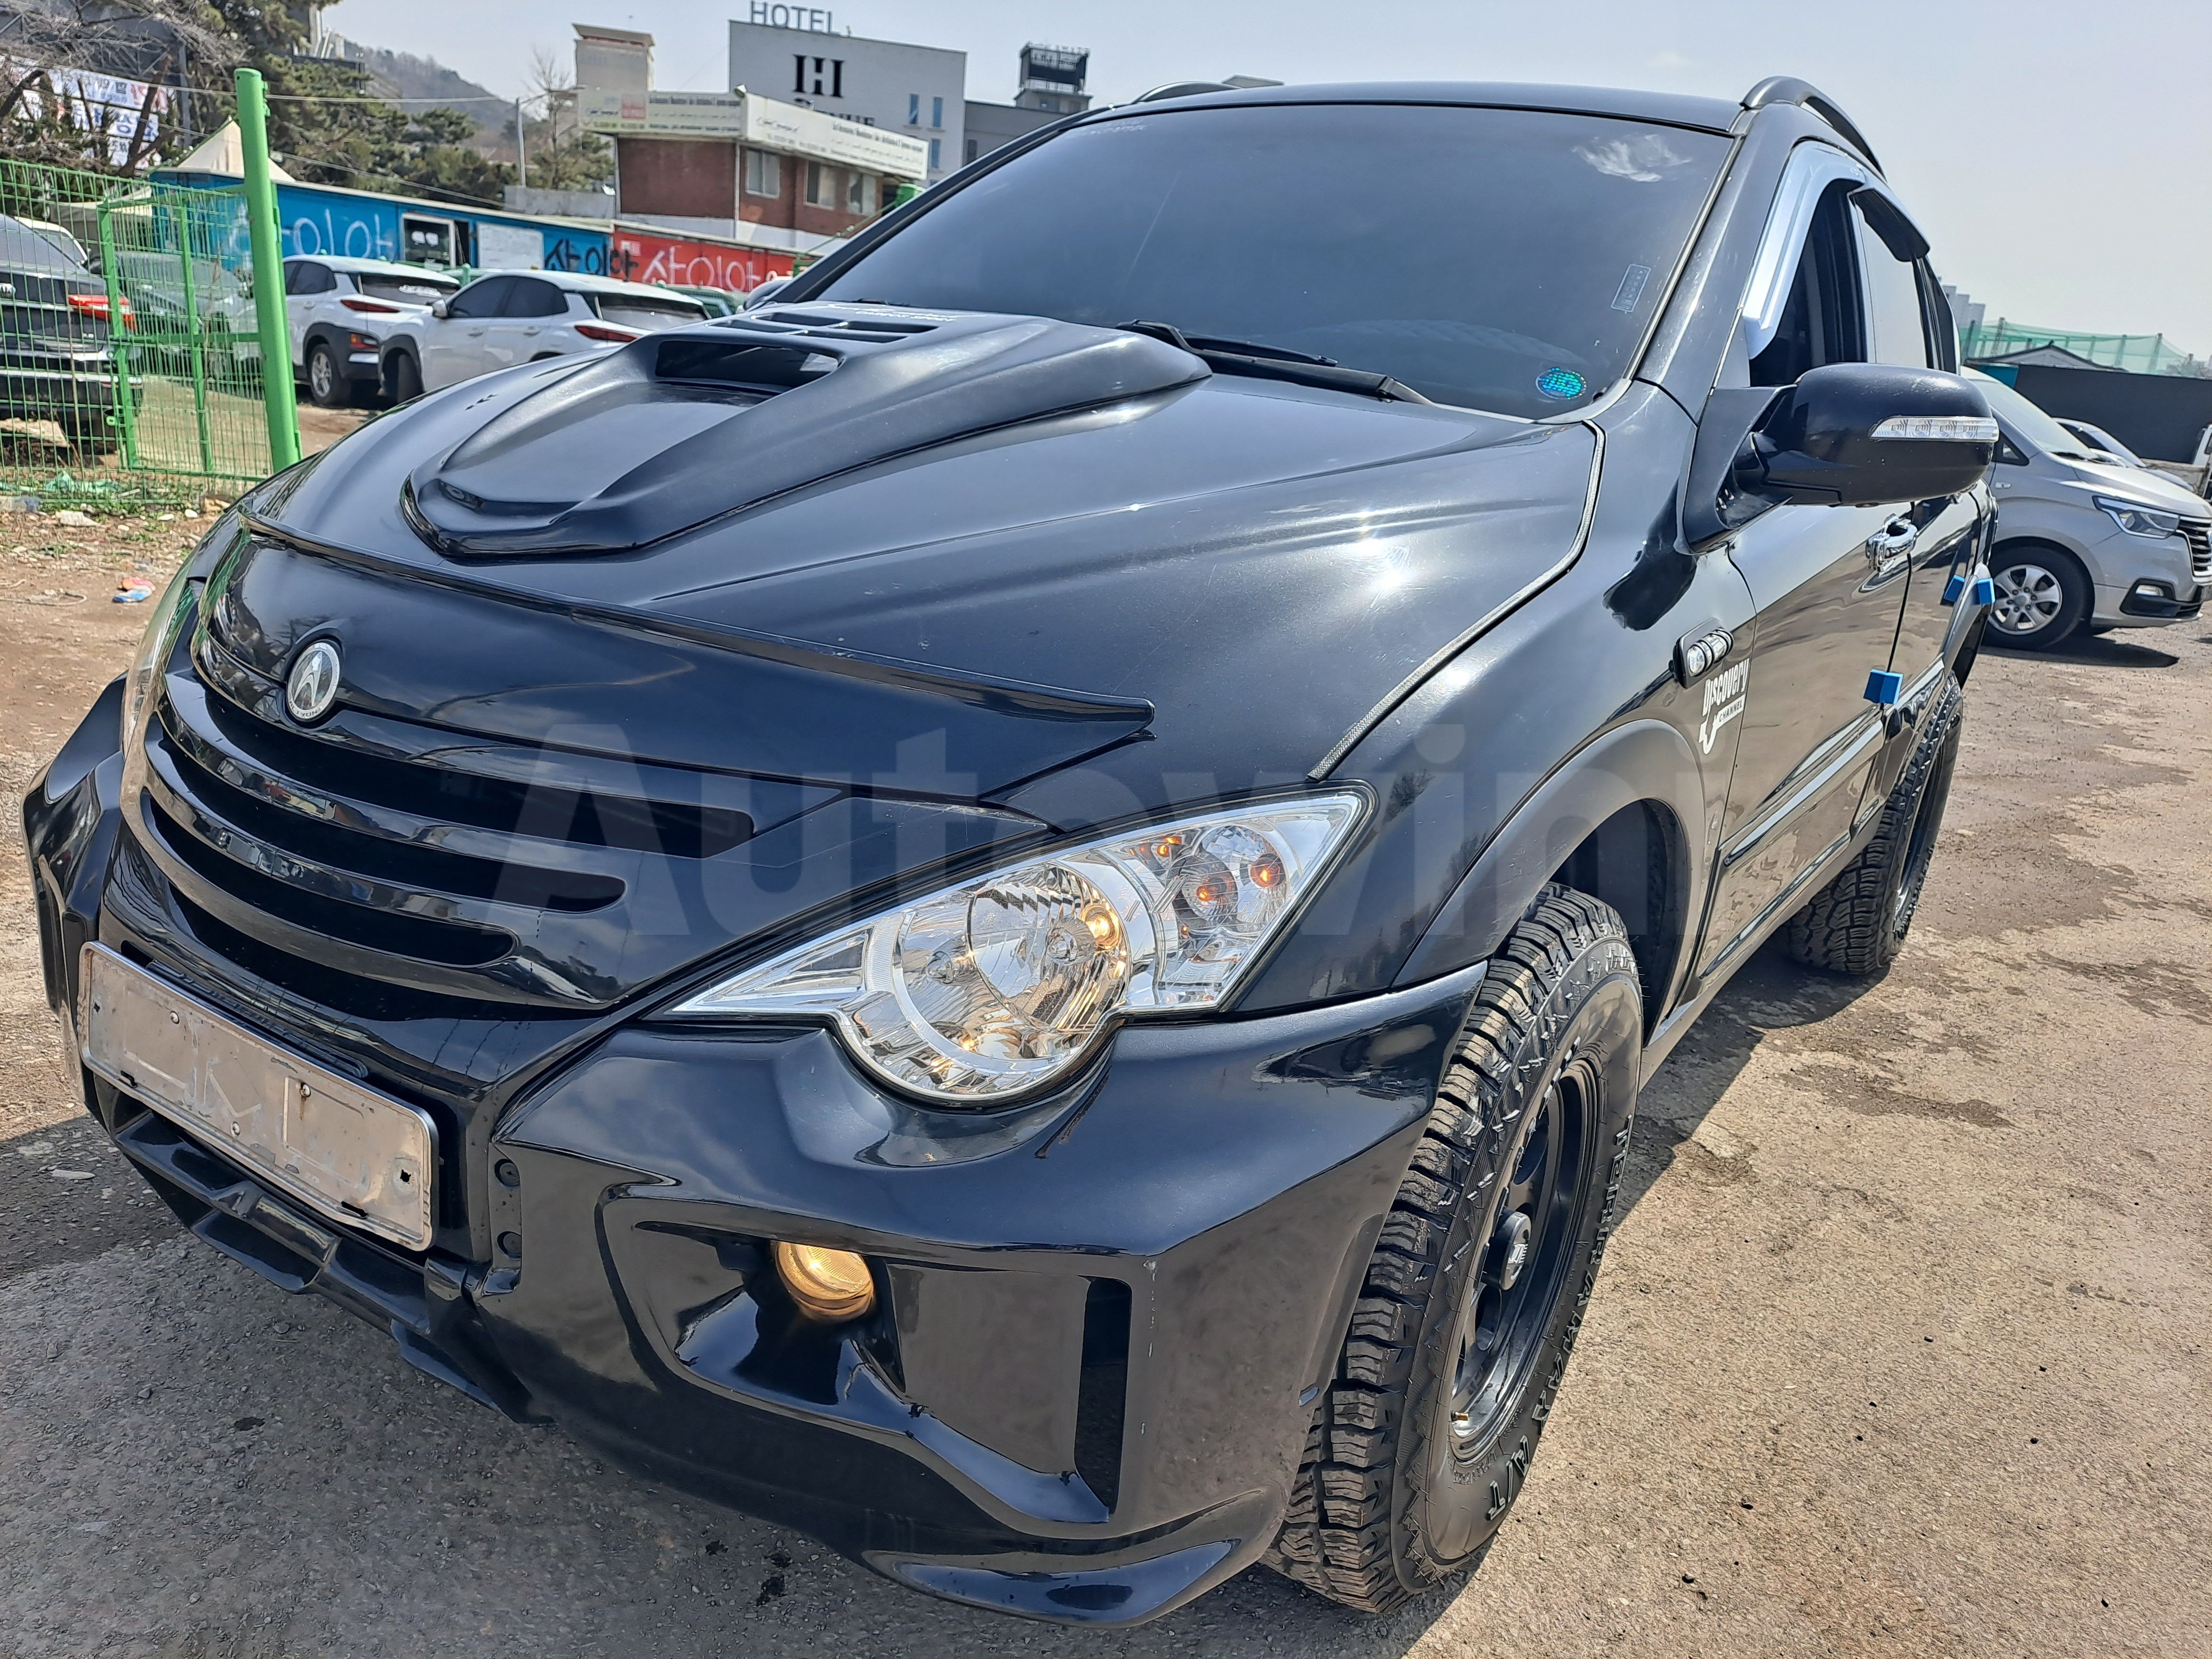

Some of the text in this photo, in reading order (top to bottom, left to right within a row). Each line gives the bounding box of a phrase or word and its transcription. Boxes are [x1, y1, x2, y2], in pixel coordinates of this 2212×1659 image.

[750, 1, 841, 35] HOTEL
[1718, 699, 1743, 722] CHANNEL
[1487, 1435, 1531, 1521] A/T
